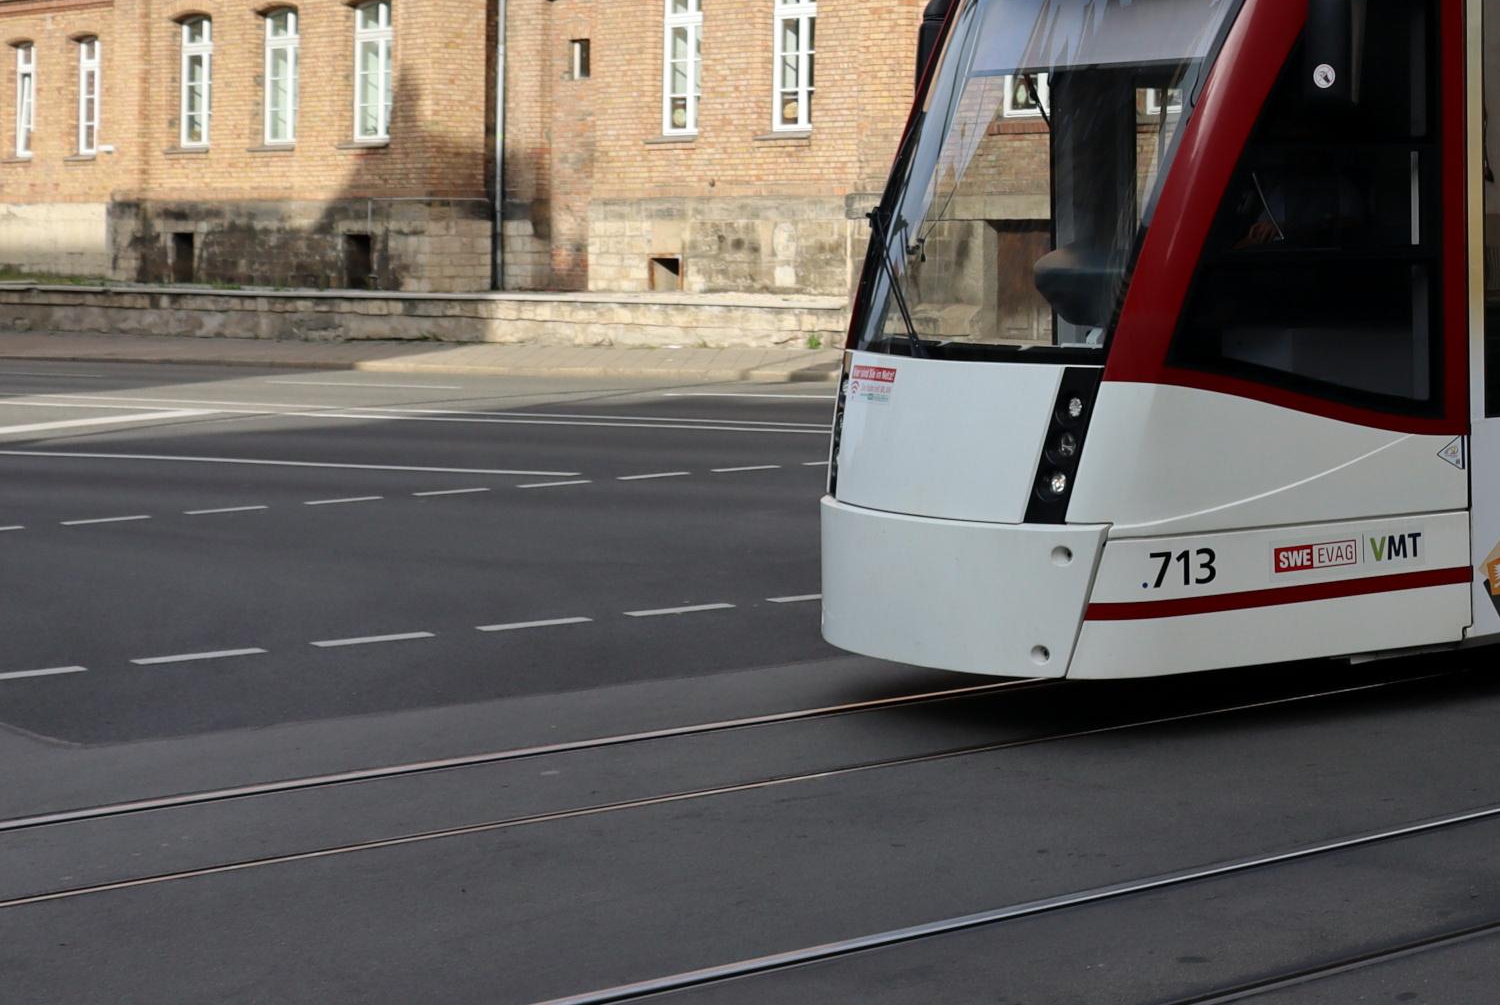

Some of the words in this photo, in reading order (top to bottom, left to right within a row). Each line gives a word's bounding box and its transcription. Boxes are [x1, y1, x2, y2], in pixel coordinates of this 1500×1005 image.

[1278, 549, 1312, 569] SWE
[1317, 544, 1355, 564] EVAG
[1370, 532, 1422, 561] VMT
